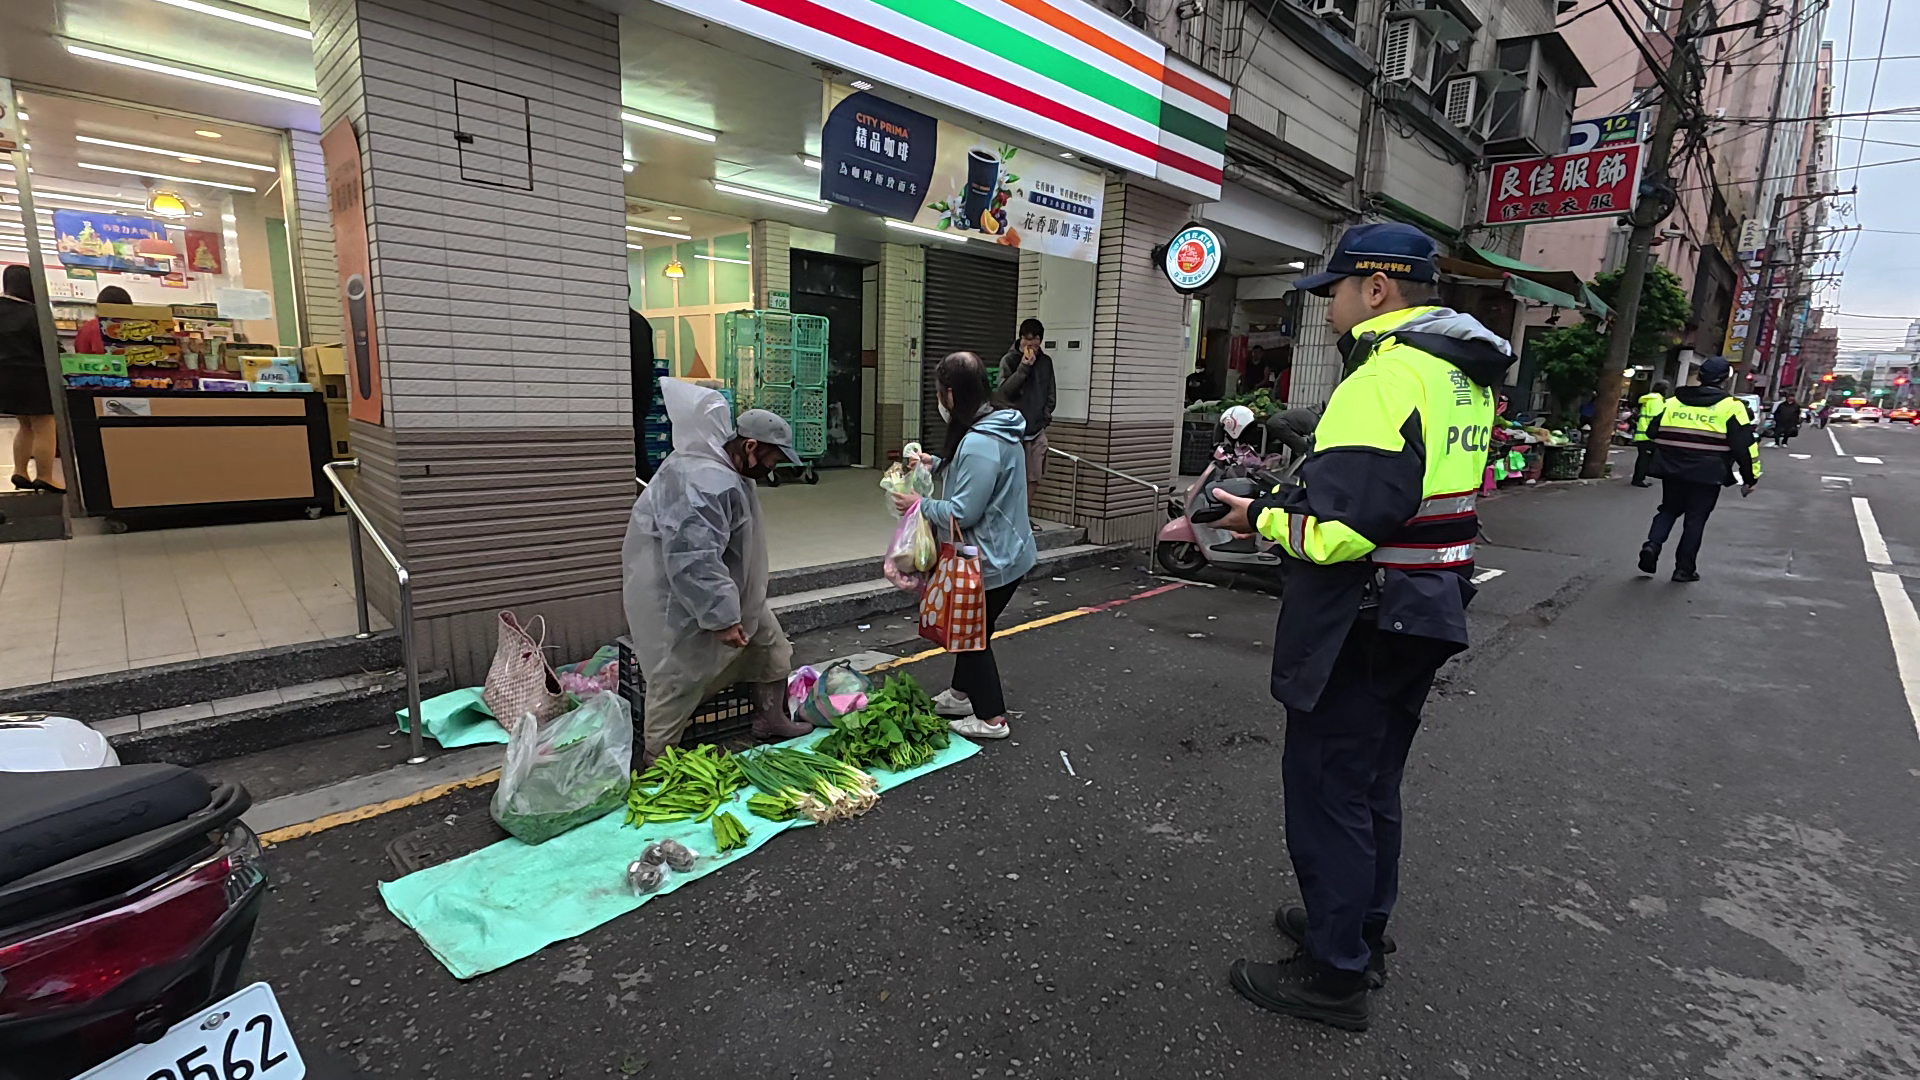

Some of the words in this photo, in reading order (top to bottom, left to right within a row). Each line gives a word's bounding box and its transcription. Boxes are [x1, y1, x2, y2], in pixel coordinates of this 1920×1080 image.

[856, 112, 878, 128] CITY
[880, 121, 909, 139] PRIMA
[855, 126, 909, 162] 精品咖啡
[839, 162, 917, 195] 為咖啡極致而生
[1498, 153, 1627, 201] 良佳服飾
[1503, 193, 1614, 219] 修改衣服
[1024, 211, 1093, 243] 花香耶加雪菲
[775, 299, 787, 308] 106
[1671, 411, 1718, 424] POLICE
[146, 1014, 288, 1080] 562
